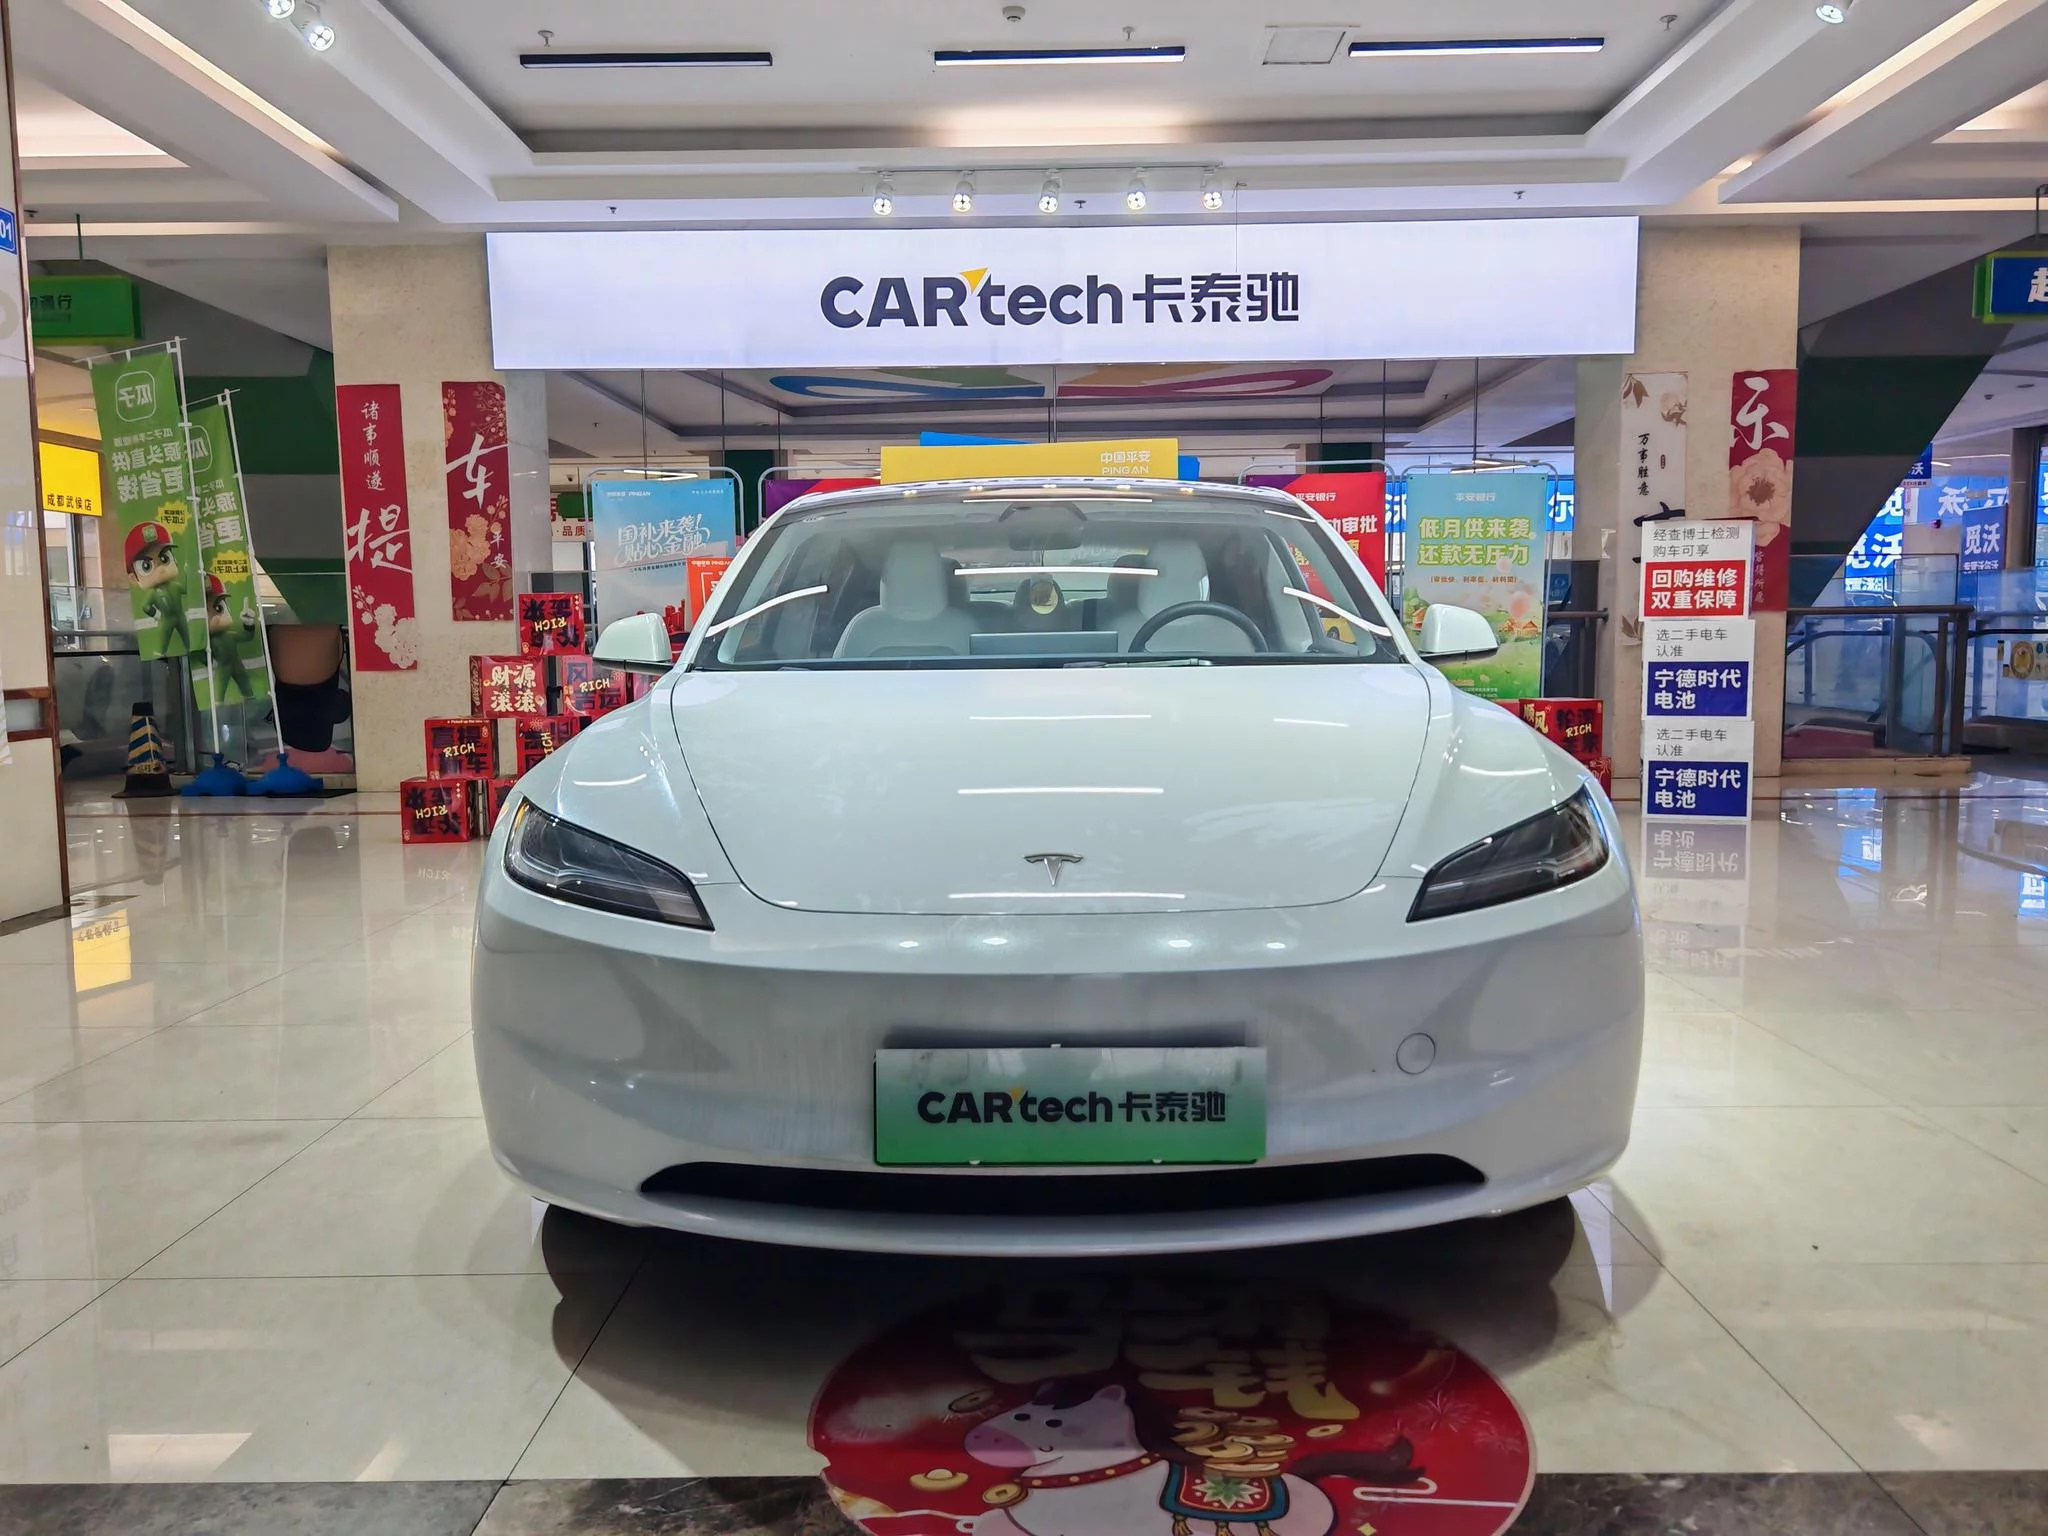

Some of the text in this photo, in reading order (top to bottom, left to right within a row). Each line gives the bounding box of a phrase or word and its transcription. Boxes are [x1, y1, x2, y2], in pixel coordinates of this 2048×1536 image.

[821, 272, 1299, 329] CARtech 卡泰驰
[1730, 376, 1790, 450] 乐
[360, 402, 386, 492] 诸事顺遂
[1100, 450, 1151, 464] 中国平安
[1637, 433, 1651, 497] 万事胜意
[445, 433, 509, 508] 车
[47, 493, 92, 512] 成都武侯店
[1296, 492, 1336, 502] 平安银行
[1455, 492, 1496, 502] 平安银行
[347, 503, 412, 573] 提
[1652, 526, 1740, 542] 经查博士检测
[1964, 523, 2000, 555] 觅沃
[1418, 544, 1530, 566] 还款无压力
[1652, 543, 1710, 558] 购车可享
[1651, 567, 1738, 590] 回购维修
[1650, 589, 1738, 611] 双重保障
[534, 616, 567, 633] RICH
[1655, 627, 1729, 643] 选二手电车
[1655, 643, 1684, 658] 认准
[490, 663, 538, 689] 财源
[579, 677, 611, 693] RICH
[1654, 668, 1742, 689] 宁德时代
[490, 689, 538, 713] 滚滚
[1654, 690, 1697, 710] 电池
[1565, 723, 1593, 738] RICH
[1655, 728, 1728, 742] 选二手电车
[443, 742, 476, 758] RICH
[1655, 743, 1684, 758] 认准
[1654, 767, 1742, 789] 宁德时代
[1654, 790, 1697, 809] 电池
[415, 804, 448, 820] RICH
[917, 1090, 1226, 1124] CARtech 卡泰驰
